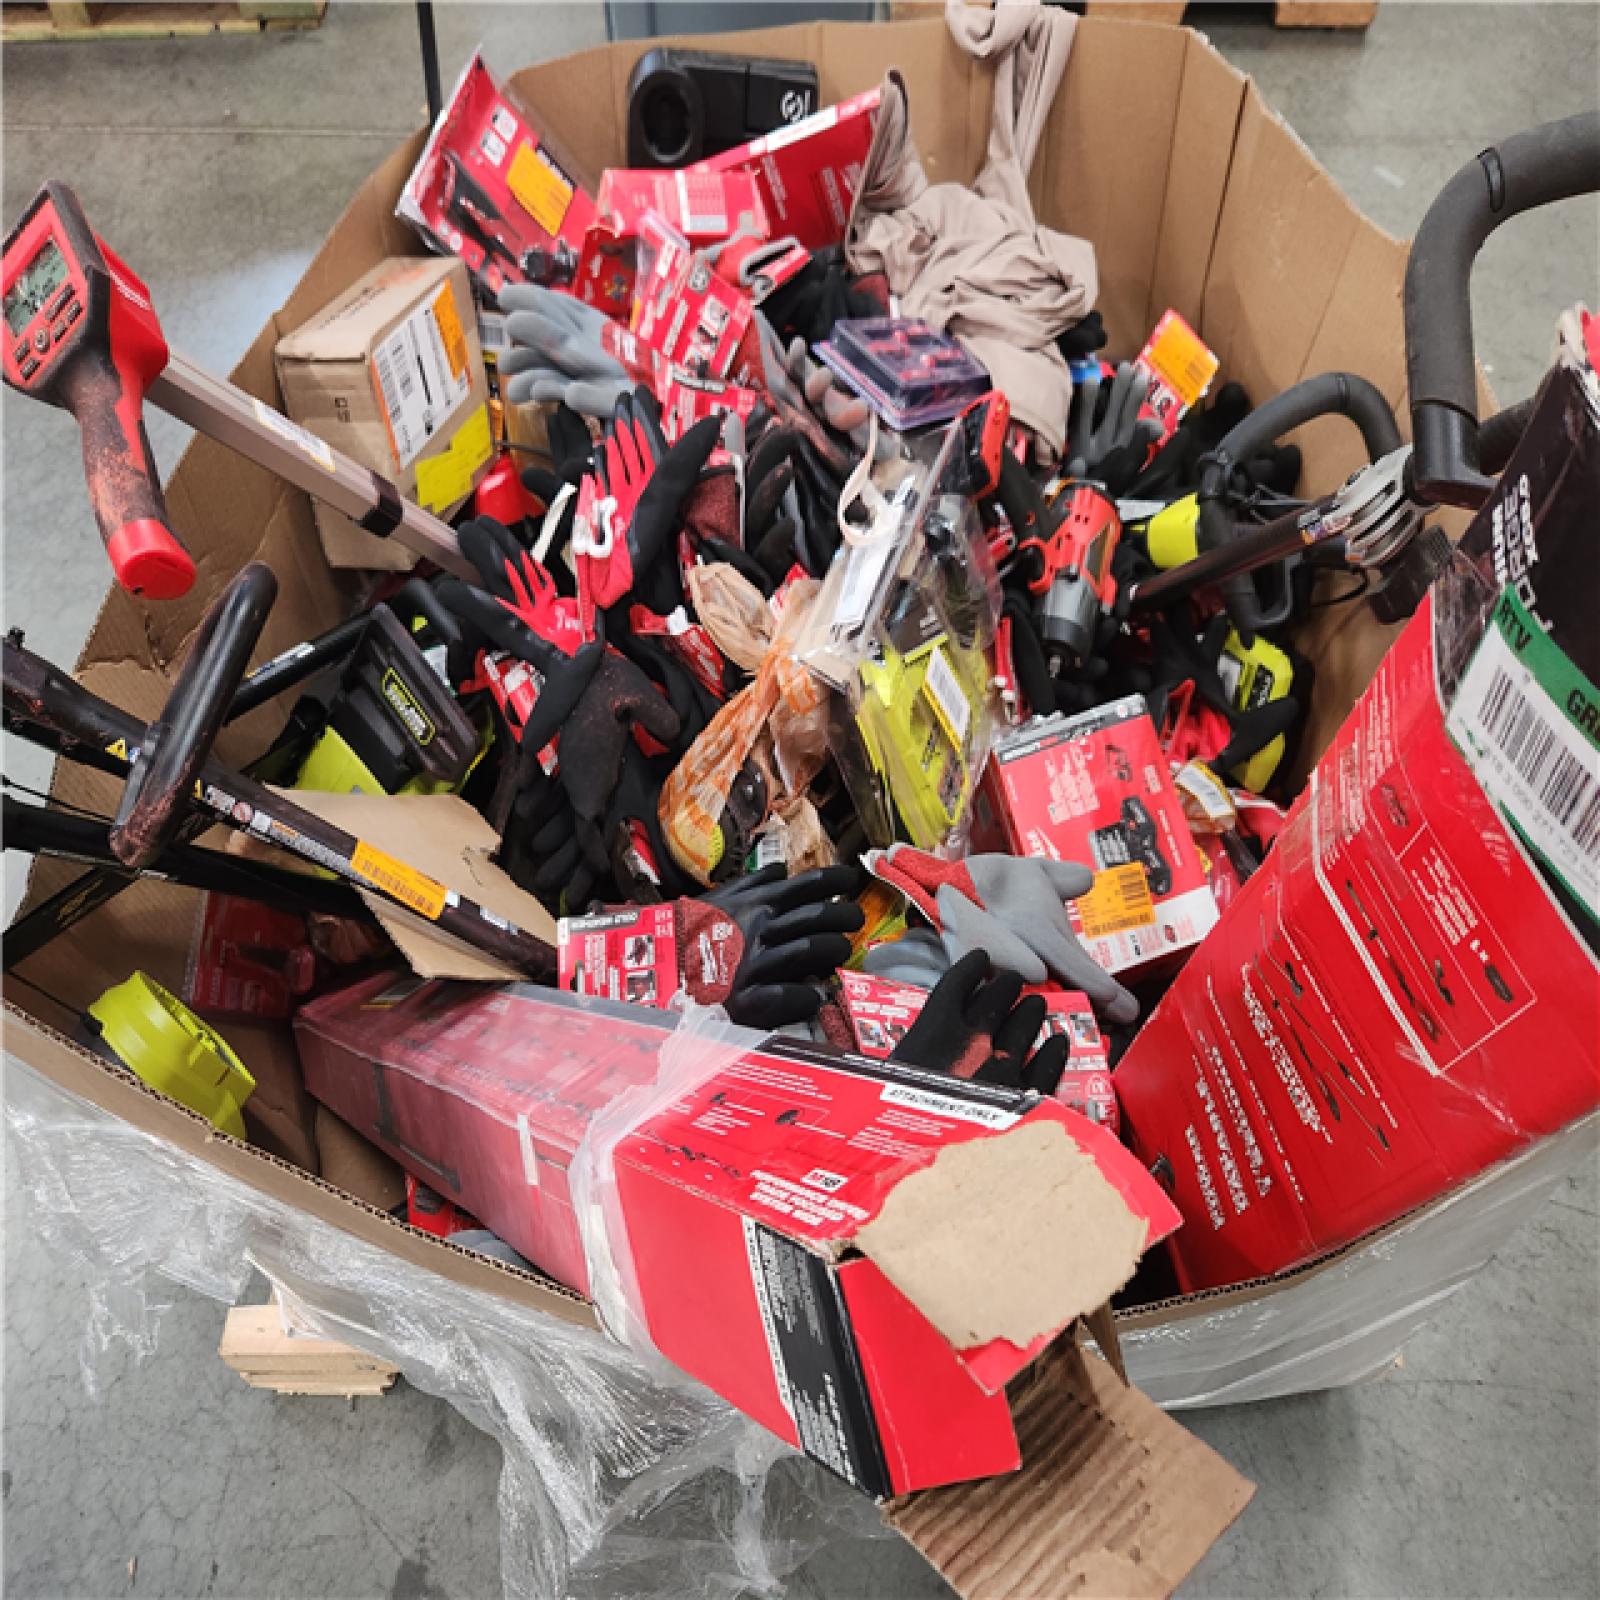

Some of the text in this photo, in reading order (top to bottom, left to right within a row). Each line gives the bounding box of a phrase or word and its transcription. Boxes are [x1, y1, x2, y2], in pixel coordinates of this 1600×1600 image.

[1503, 484, 1555, 634] FORGE
[1497, 595, 1533, 652] RTV
[749, 1168, 829, 1203] PERFORMANCE
[748, 1191, 824, 1227] SYSTEM WIDE
